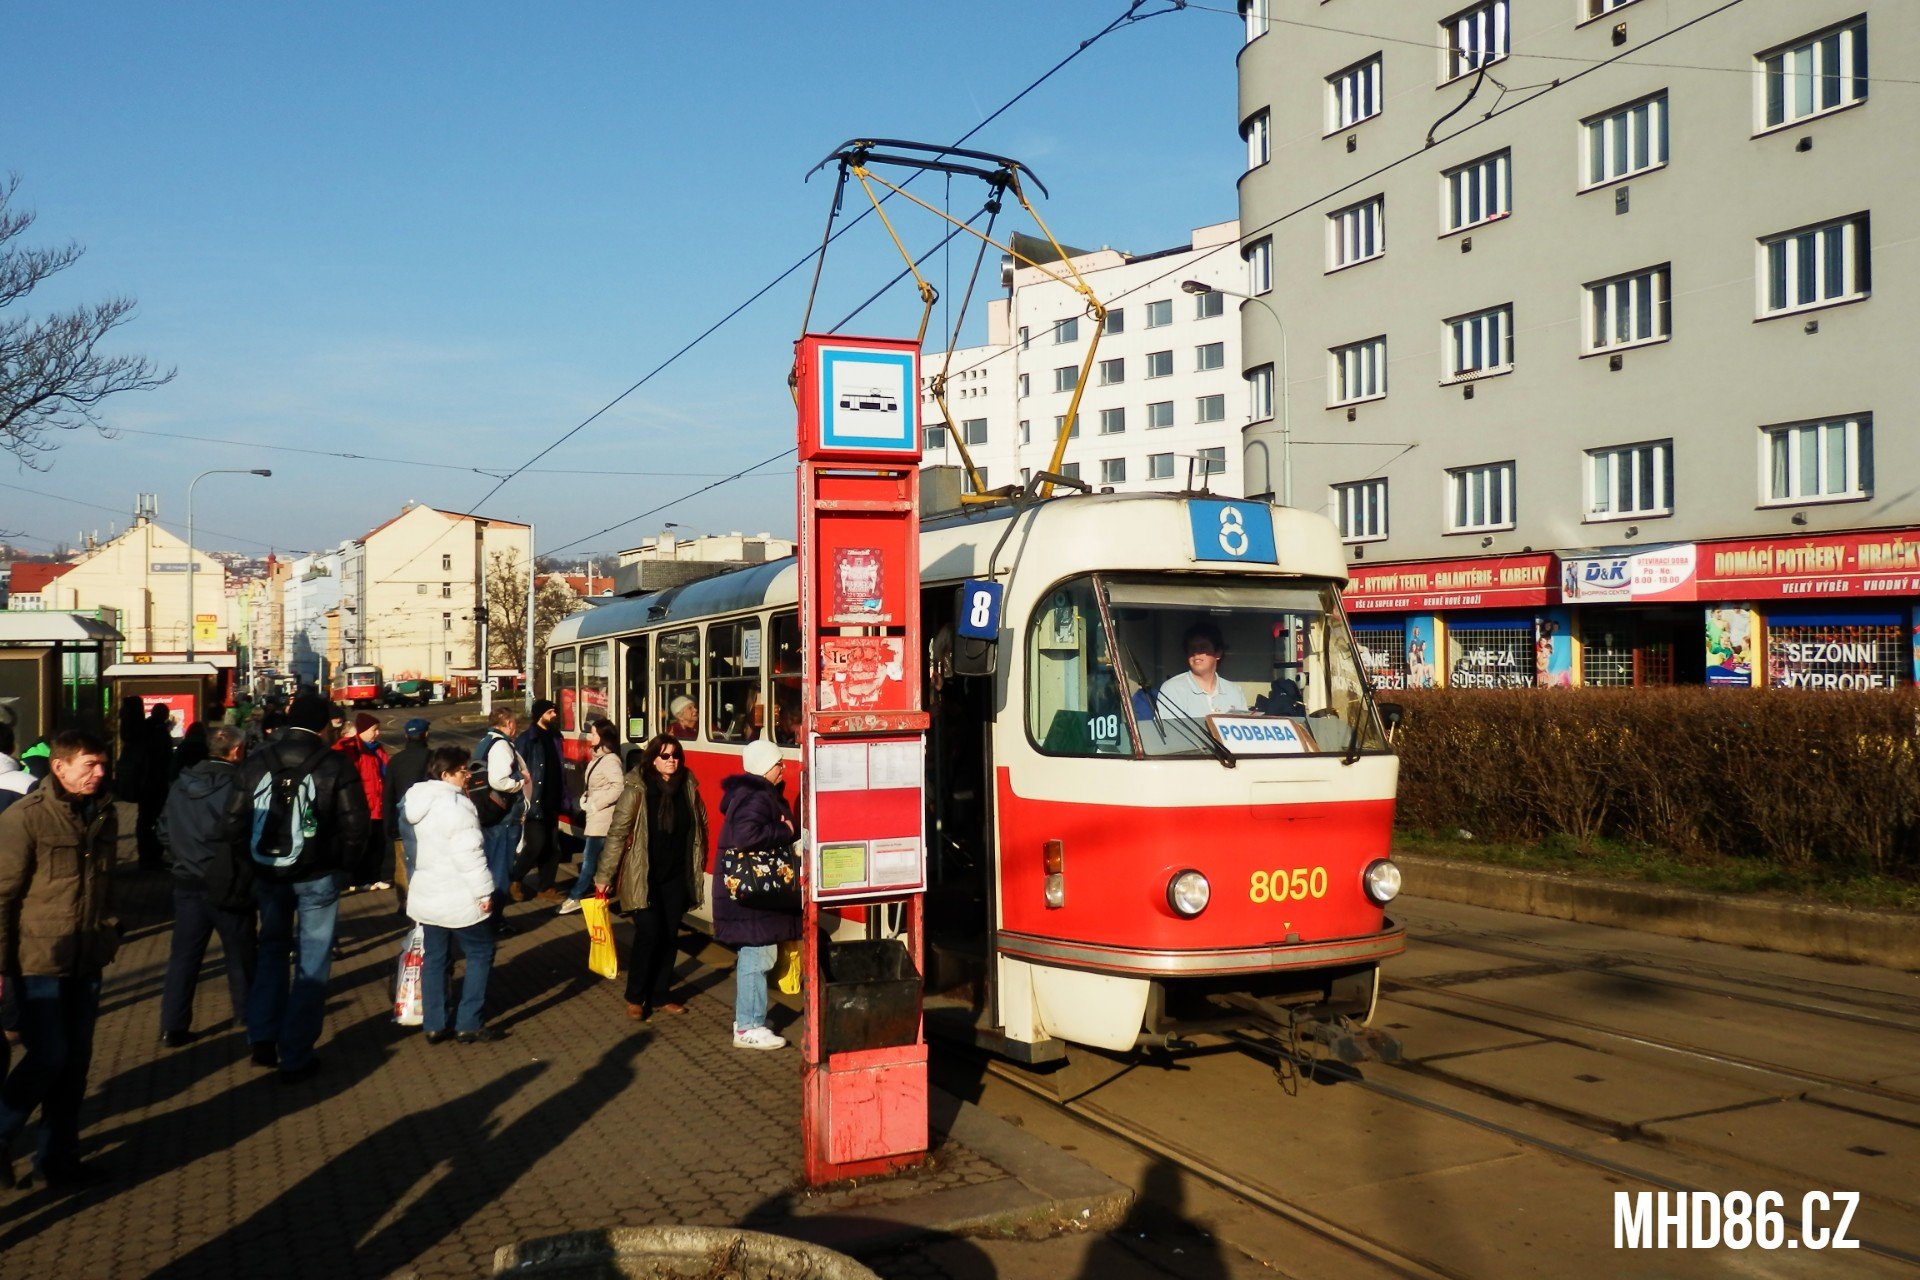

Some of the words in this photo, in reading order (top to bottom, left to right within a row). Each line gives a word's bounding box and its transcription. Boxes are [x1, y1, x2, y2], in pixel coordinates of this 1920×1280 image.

[1219, 506, 1248, 556] 8
[1585, 561, 1627, 581] D&K
[1715, 545, 1773, 576] DOMÁCÍ
[1776, 543, 1845, 574] POTŘEBY
[1365, 573, 1398, 593] BYTOVÝ
[1399, 573, 1427, 592] TEXTIL
[1435, 568, 1492, 589] GALANTÉRIE
[1500, 566, 1546, 586] KABELKY
[1782, 581, 1812, 593] VELKÝ
[1815, 580, 1849, 592] VÝBĚR
[1863, 577, 1908, 591] VHODNÝ
[1911, 579, 1920, 590] N
[970, 591, 991, 627] 8
[1375, 599, 1394, 608] SUPER
[1469, 647, 1495, 666] VŠE
[1088, 714, 1118, 740] 108
[1219, 725, 1297, 742] PODBABA
[1250, 867, 1328, 903] 8050
